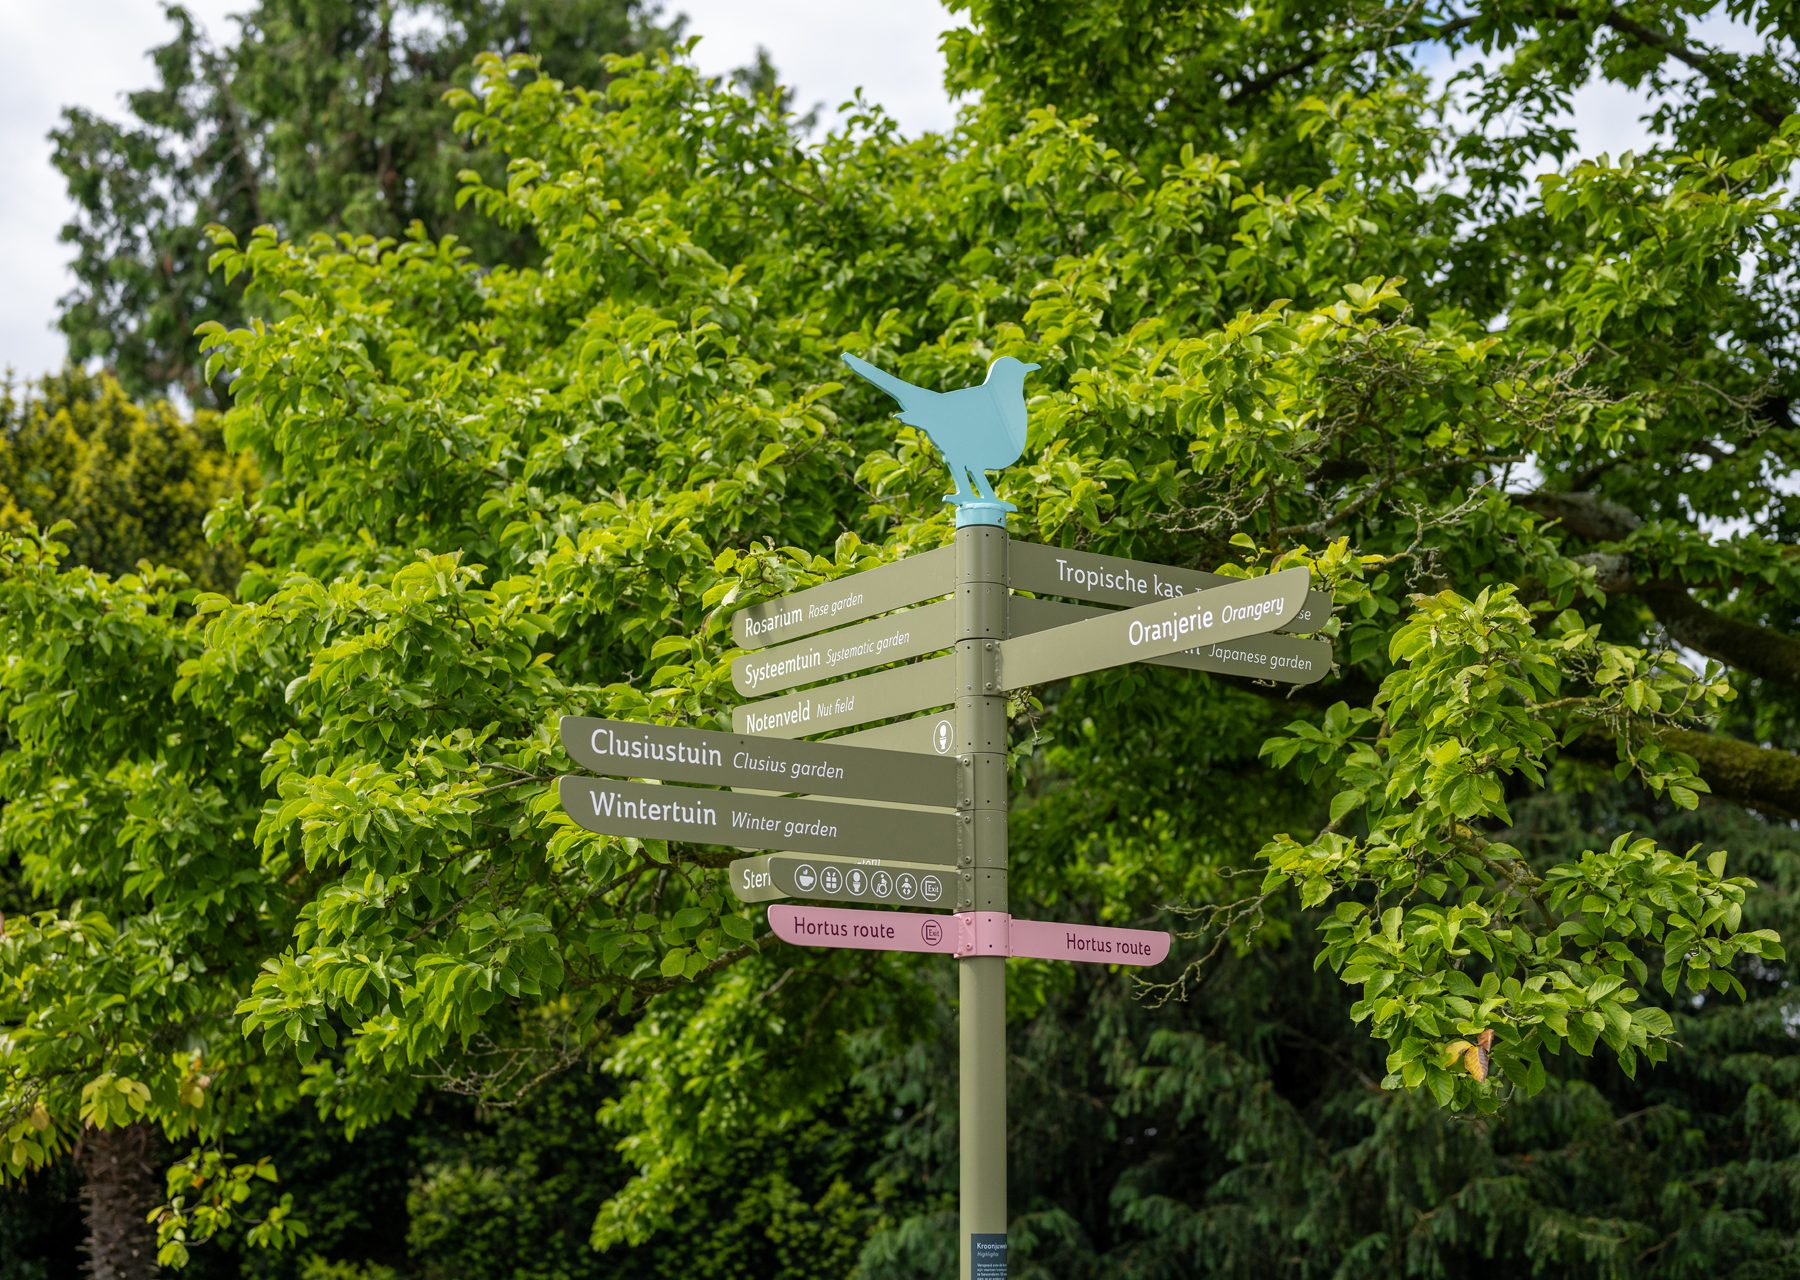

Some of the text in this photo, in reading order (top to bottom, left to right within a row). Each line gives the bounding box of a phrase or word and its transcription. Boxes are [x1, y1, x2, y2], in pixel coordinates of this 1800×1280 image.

[1056, 559, 1184, 598] Tropische kas
[745, 593, 863, 638] Rosarium Rose garden
[1128, 597, 1285, 646] Oranjerie Orangery
[744, 630, 910, 688] Systeemtuin Systematic garden
[1208, 643, 1267, 665] Japanese
[1270, 655, 1312, 671] garden
[746, 696, 855, 734] Notenveld Nut field
[590, 728, 844, 779] Clusiustuin Clusius garden
[589, 790, 838, 838] Wintertuin Winter garden
[928, 884, 939, 893] Exit
[794, 916, 895, 939] Hortus route
[928, 928, 940, 937] Exit
[1066, 932, 1151, 956] Hortus route
